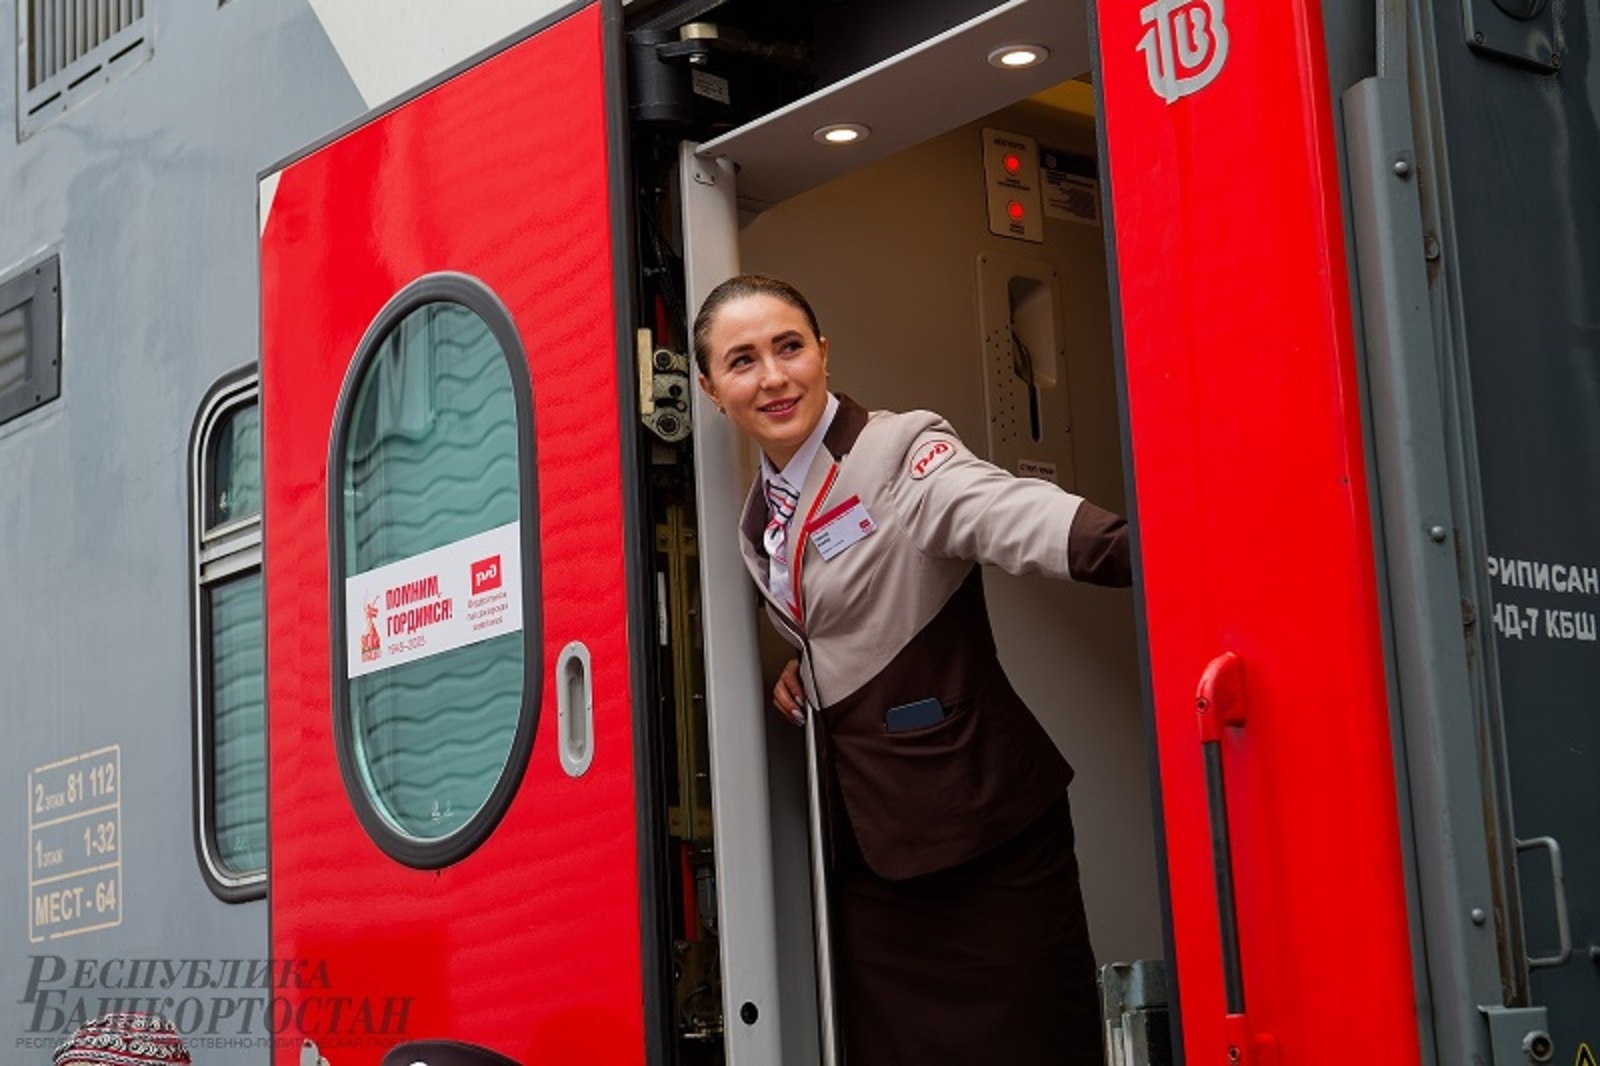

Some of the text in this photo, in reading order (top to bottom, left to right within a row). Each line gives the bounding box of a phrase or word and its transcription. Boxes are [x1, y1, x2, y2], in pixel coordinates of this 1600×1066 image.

[386, 574, 442, 611] ПОМНИМ,
[387, 598, 453, 637] ГОРДИМСЯ!
[1545, 609, 1597, 641] КБШ
[35, 783, 45, 813] 2
[35, 839, 42, 868] 1
[83, 821, 115, 857] 1-32
[35, 887, 84, 926] МЕСТ
